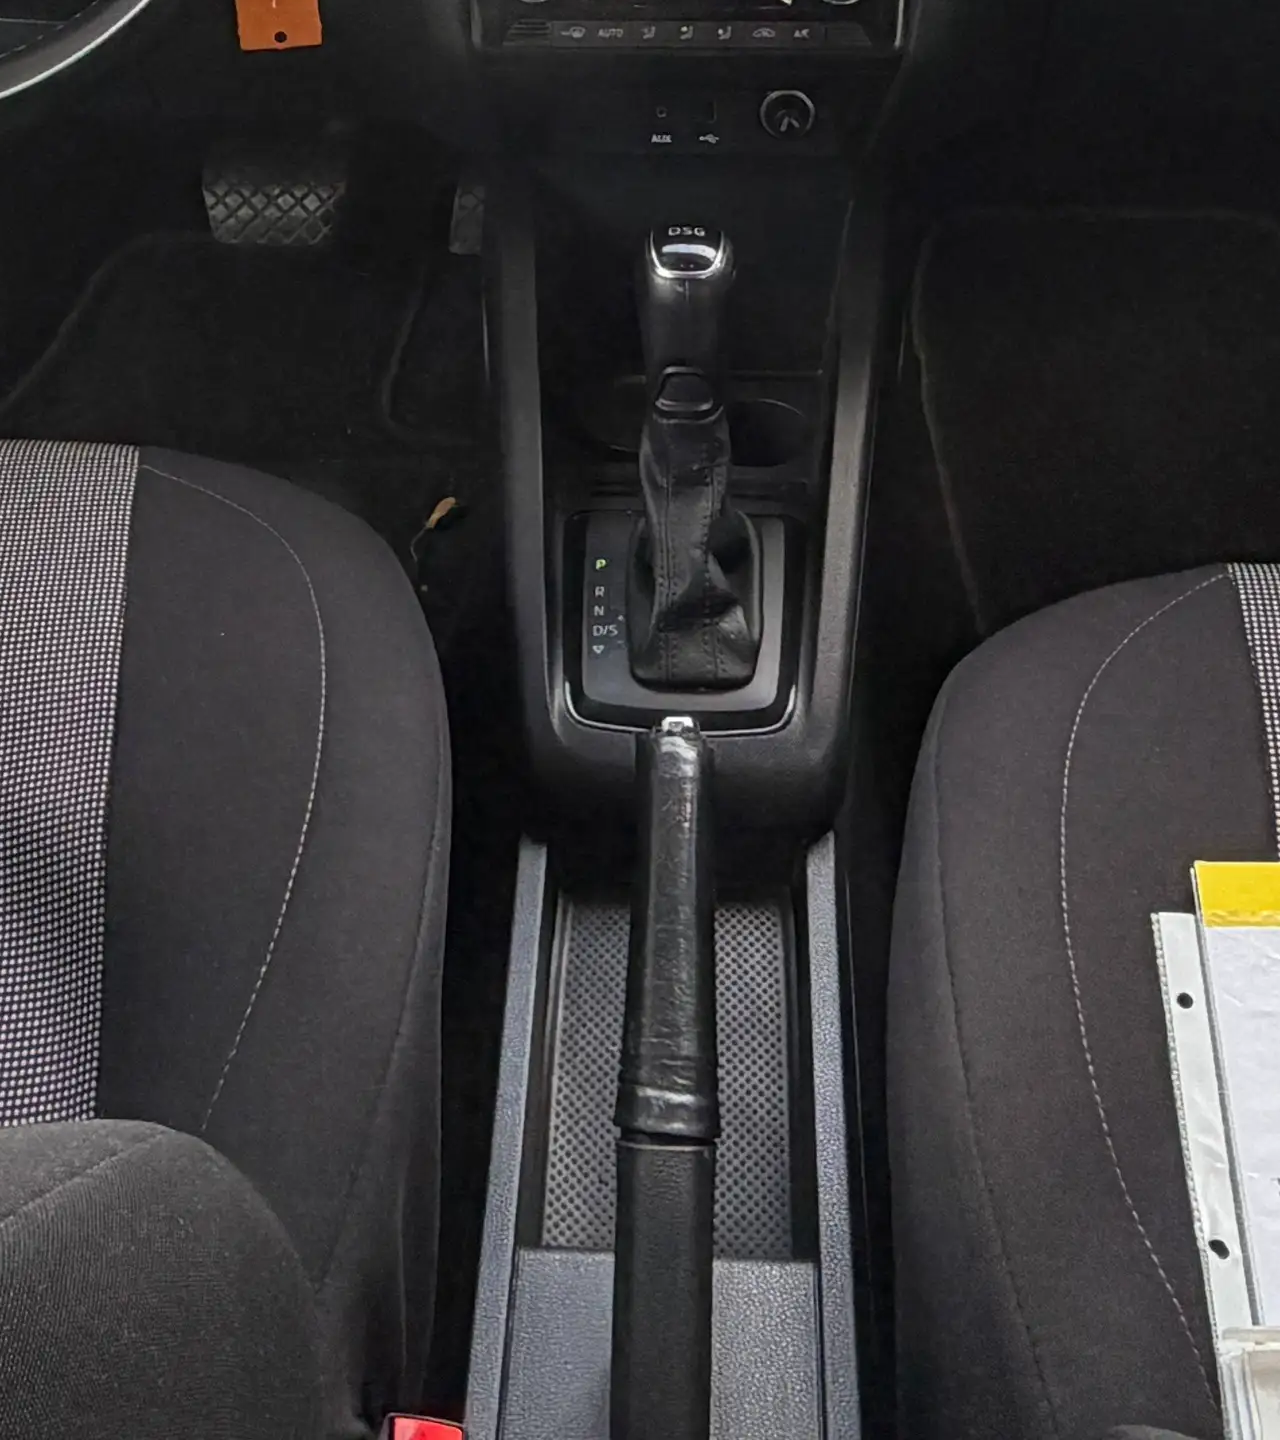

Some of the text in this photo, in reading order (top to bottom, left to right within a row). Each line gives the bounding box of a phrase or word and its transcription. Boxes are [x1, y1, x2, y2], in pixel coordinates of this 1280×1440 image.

[668, 226, 706, 237] DSG
[595, 559, 607, 570] P
[595, 586, 605, 598] R
[593, 605, 604, 616] N
[592, 625, 619, 637] D/S
